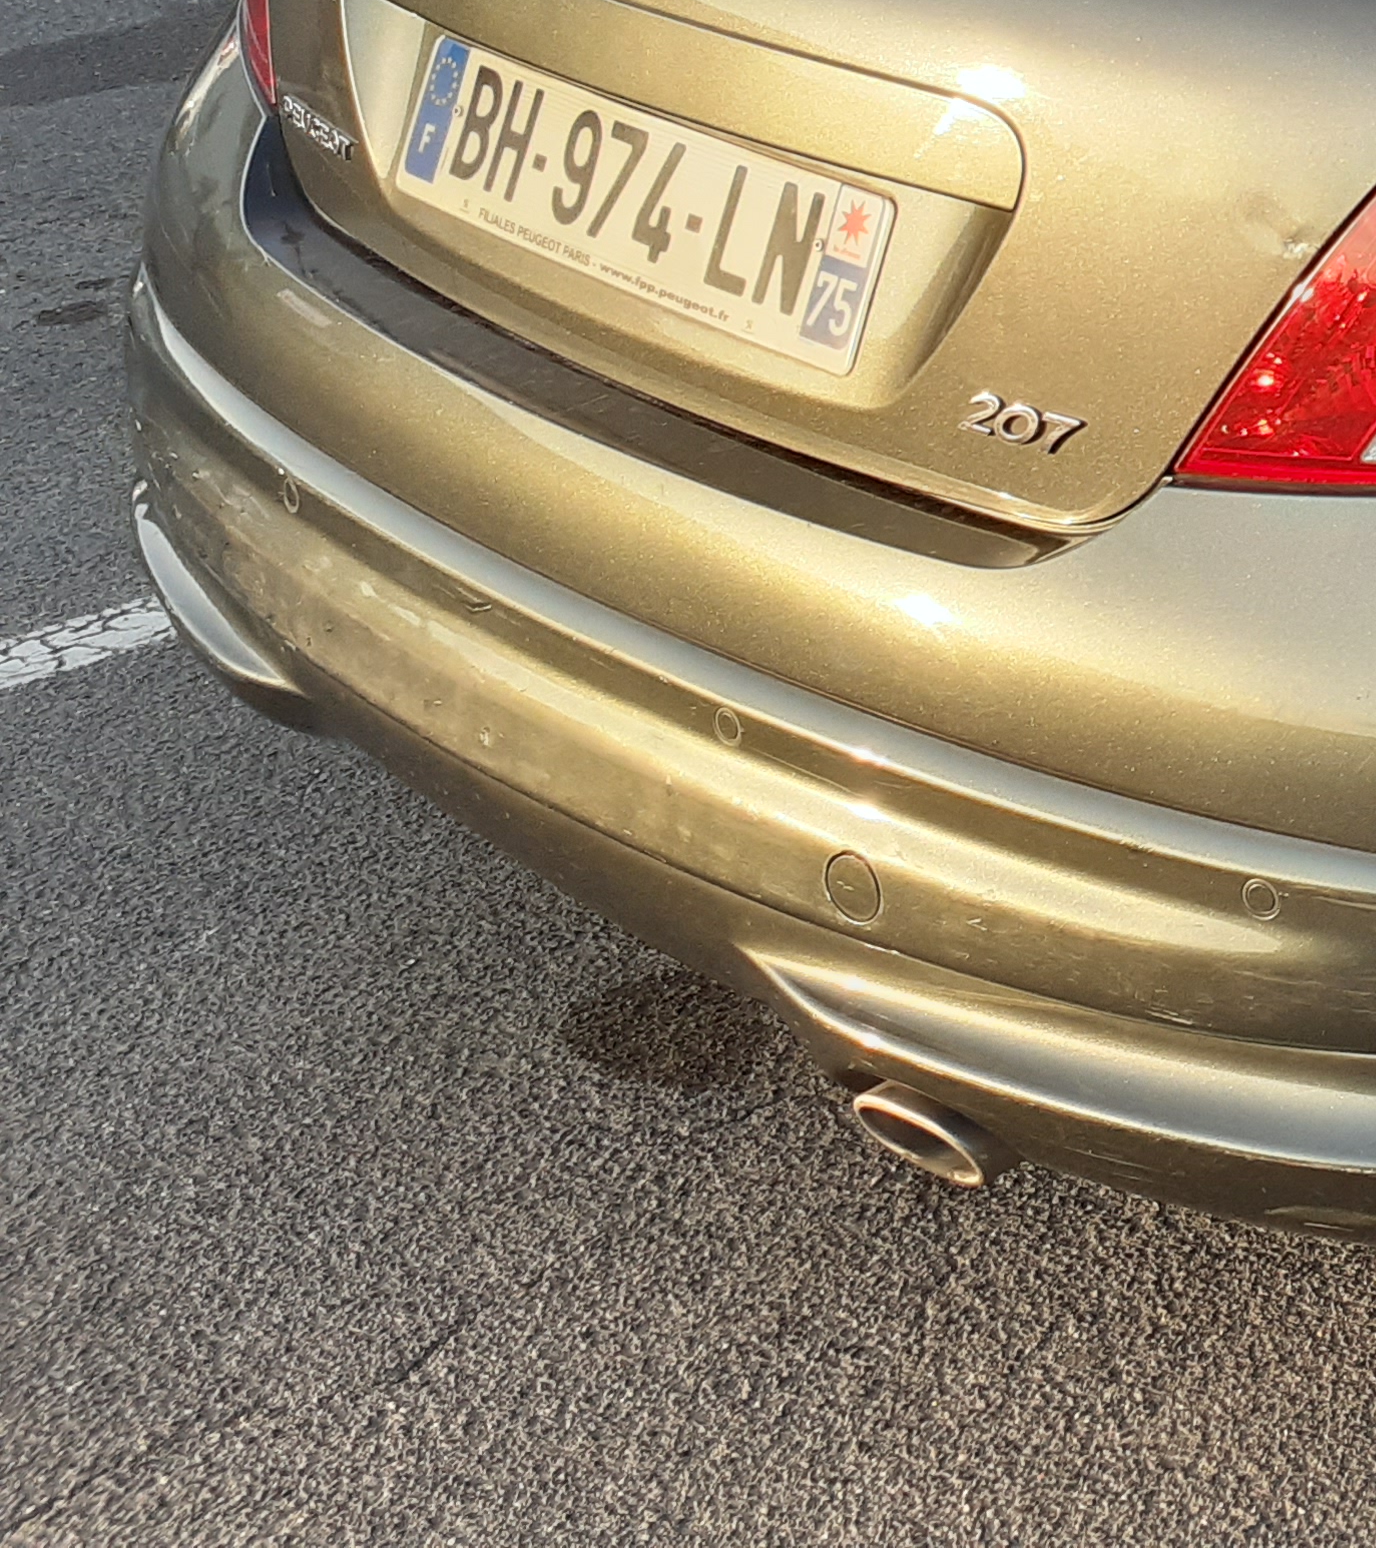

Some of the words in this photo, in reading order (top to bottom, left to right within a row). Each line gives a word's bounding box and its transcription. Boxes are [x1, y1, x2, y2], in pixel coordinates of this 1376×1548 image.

[418, 123, 436, 154] F
[479, 208, 515, 235] FILIALES
[517, 226, 562, 253] PEUGEOT
[562, 245, 592, 267] PARIS
[600, 263, 730, 322] www.fpp.peugeot.fr
[806, 271, 858, 337] 75
[957, 390, 1088, 455] 207
